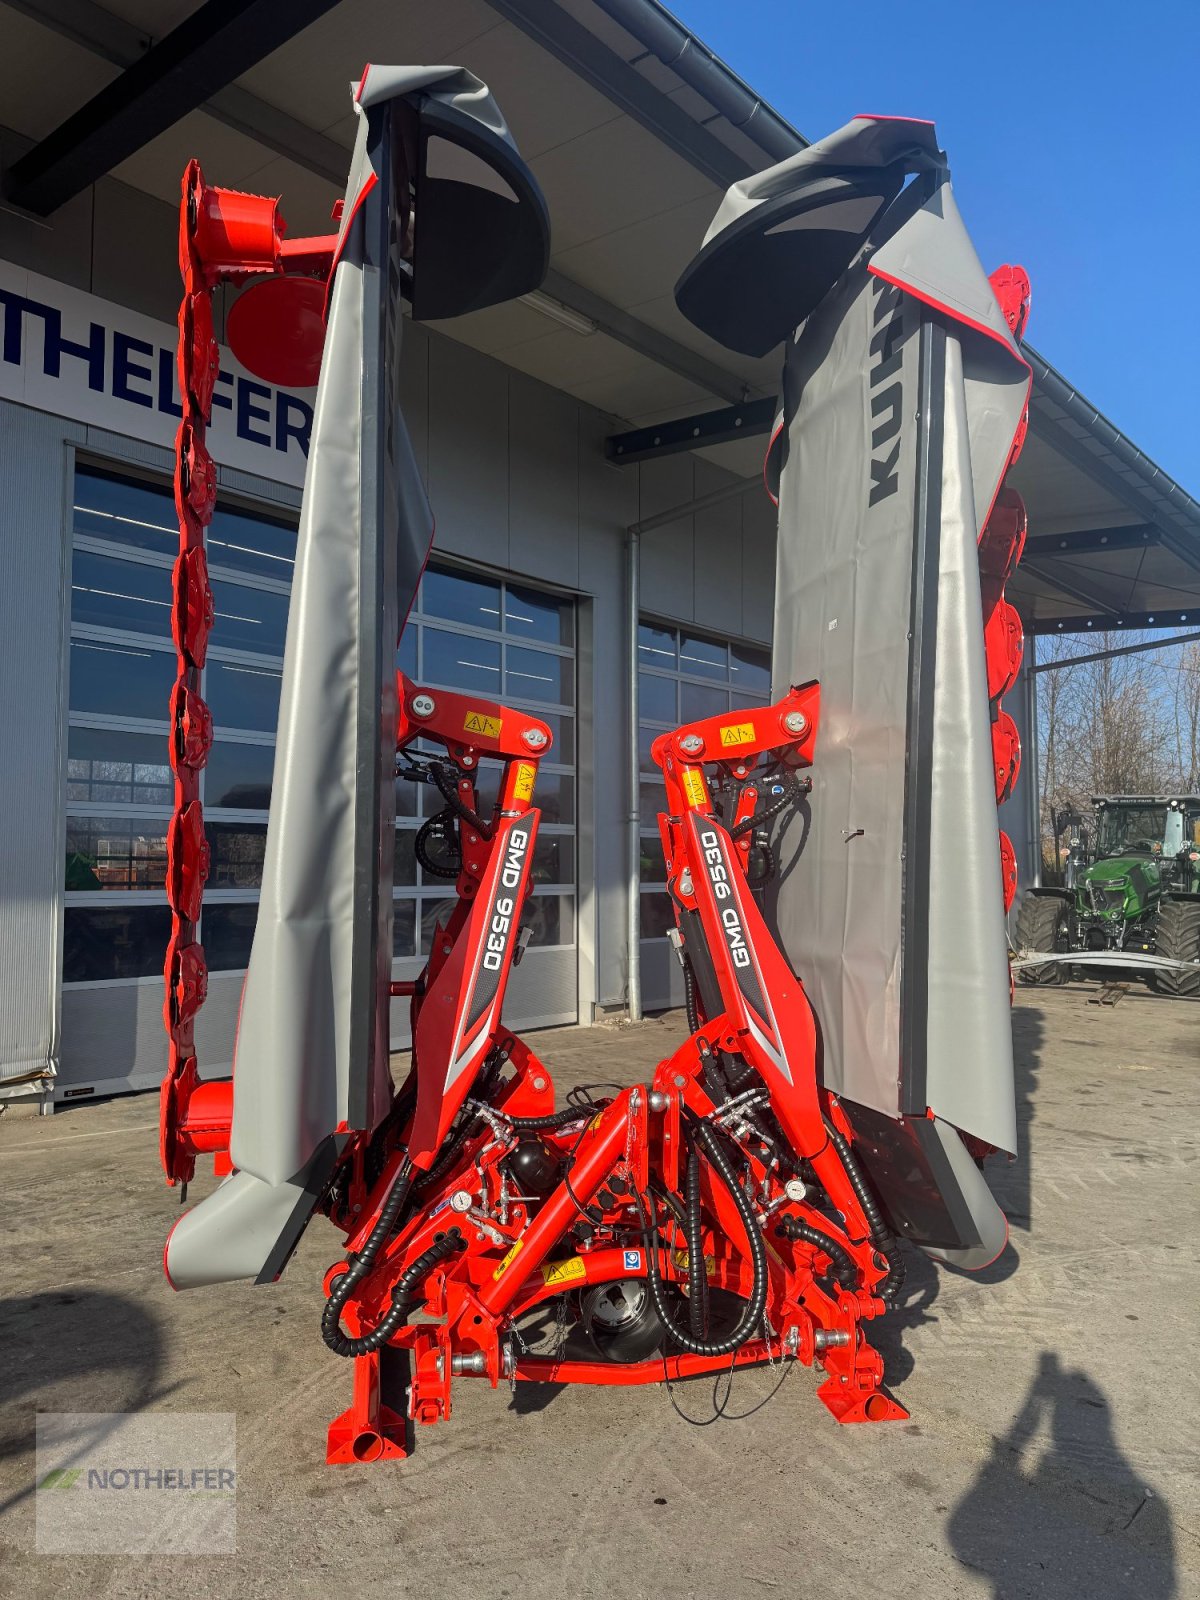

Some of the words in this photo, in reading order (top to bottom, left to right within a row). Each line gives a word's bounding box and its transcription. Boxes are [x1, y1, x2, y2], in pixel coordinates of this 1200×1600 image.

[868, 275, 904, 508] KUHN
[501, 829, 528, 888] GMD
[700, 830, 732, 899] 9530
[482, 897, 514, 971] 9530
[722, 908, 750, 968] GMD
